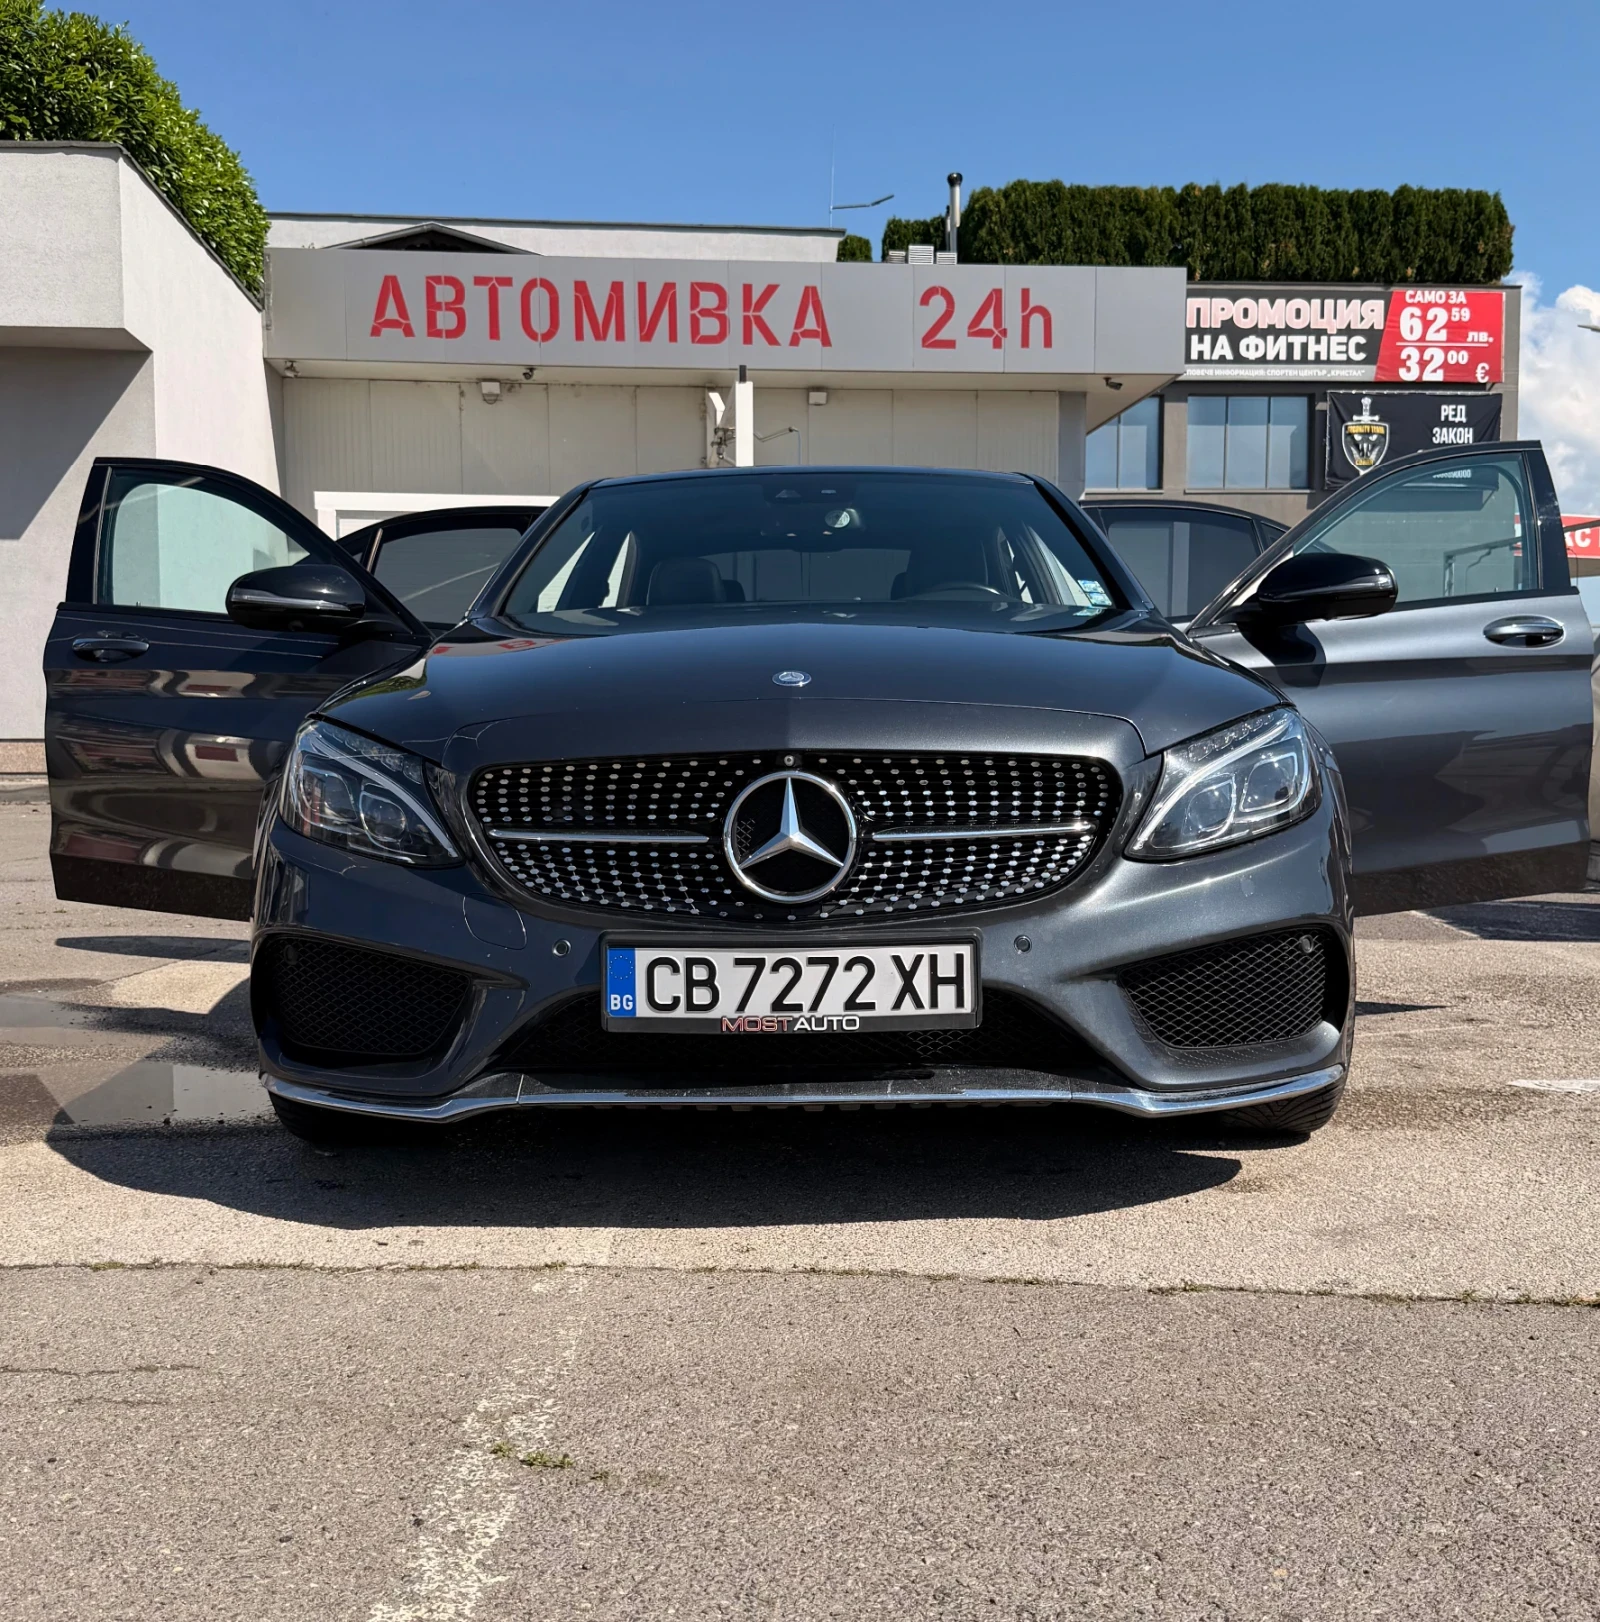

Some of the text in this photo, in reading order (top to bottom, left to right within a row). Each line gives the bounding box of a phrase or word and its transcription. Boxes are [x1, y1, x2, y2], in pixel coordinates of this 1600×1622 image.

[370, 274, 1053, 349] АВТОМИВКА 24h
[1405, 290, 1467, 304] САМО ЗА
[1186, 297, 1385, 334] ПРОМОЦИЯ
[1400, 306, 1448, 341] 62
[1466, 331, 1494, 343] лв.
[1190, 335, 1367, 362] НА ФИТНЕС
[1398, 346, 1445, 382] 32
[1475, 362, 1489, 383] €
[1440, 404, 1467, 423] РЕД
[1432, 427, 1473, 444] ЗАКОН
[645, 952, 966, 1013] CB 7272 XH
[609, 994, 634, 1011] BG
